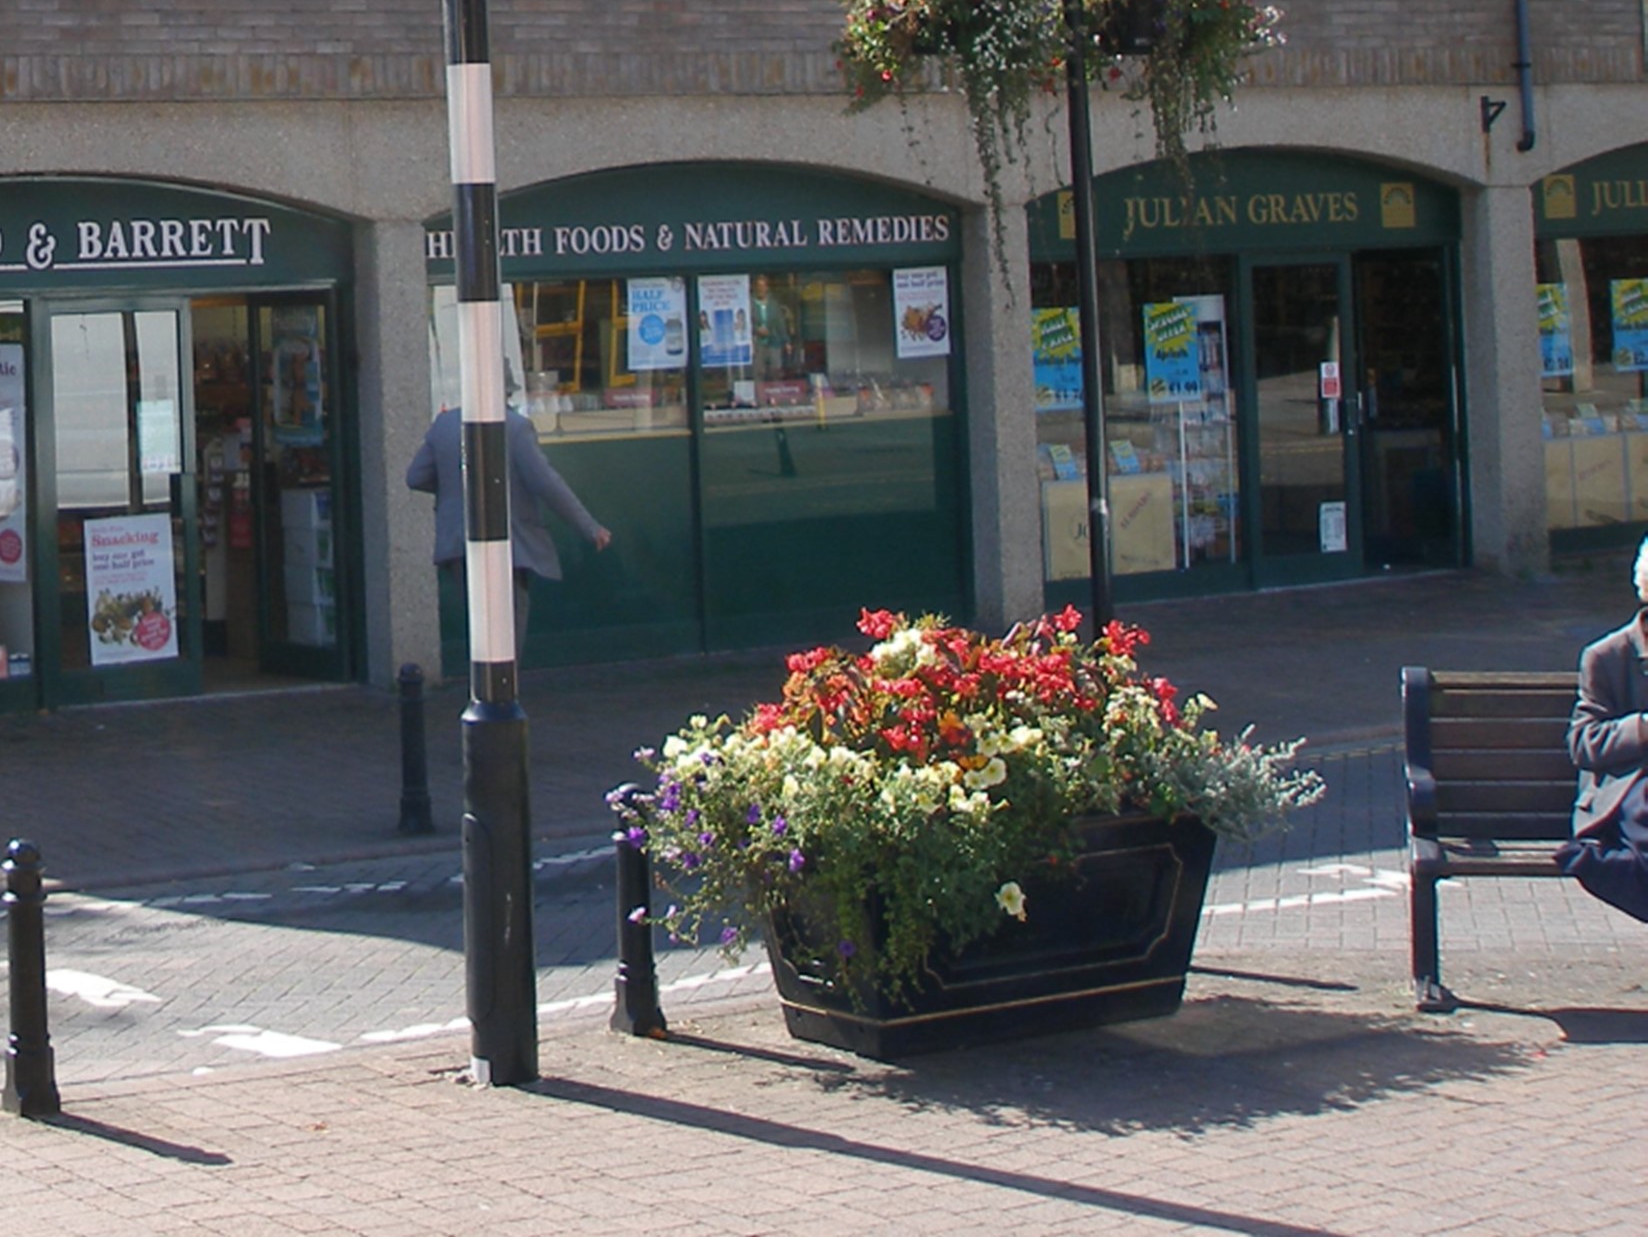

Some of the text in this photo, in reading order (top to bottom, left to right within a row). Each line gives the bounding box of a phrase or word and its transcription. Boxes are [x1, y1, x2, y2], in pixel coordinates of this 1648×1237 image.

[1247, 192, 1358, 224] GRAVES
[26, 222, 56, 270] &
[77, 217, 271, 265] BARRETT
[426, 214, 950, 259] HTH FOODS & NATURAL REMEDIES
[92, 532, 159, 547] Snacking
